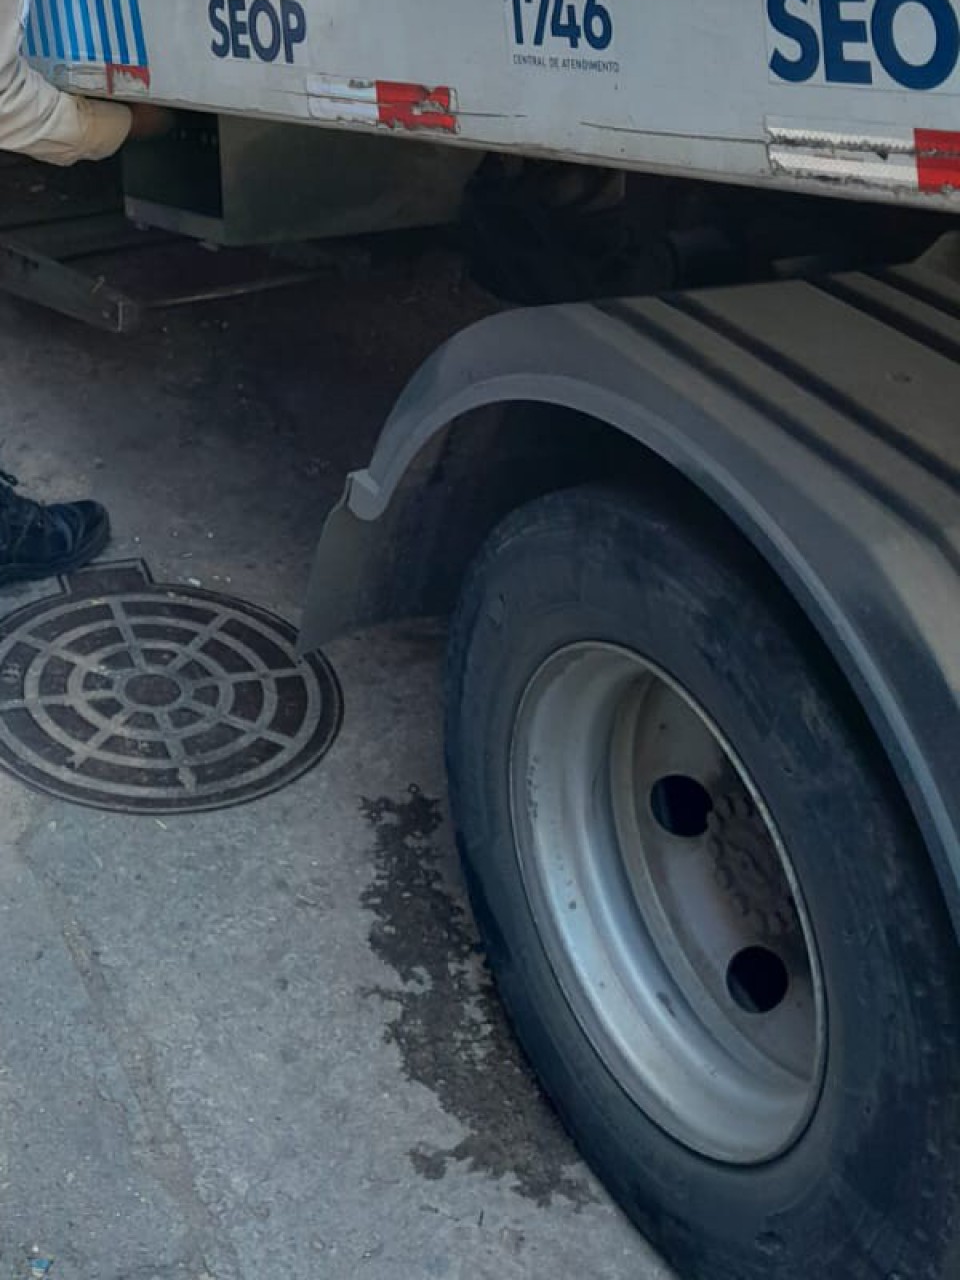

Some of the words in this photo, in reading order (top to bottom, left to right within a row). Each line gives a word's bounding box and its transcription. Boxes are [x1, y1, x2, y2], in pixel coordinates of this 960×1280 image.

[512, 54, 544, 66] CENTRAL
[548, 56, 559, 68] DE
[561, 58, 620, 73] ATENDIMENTO
